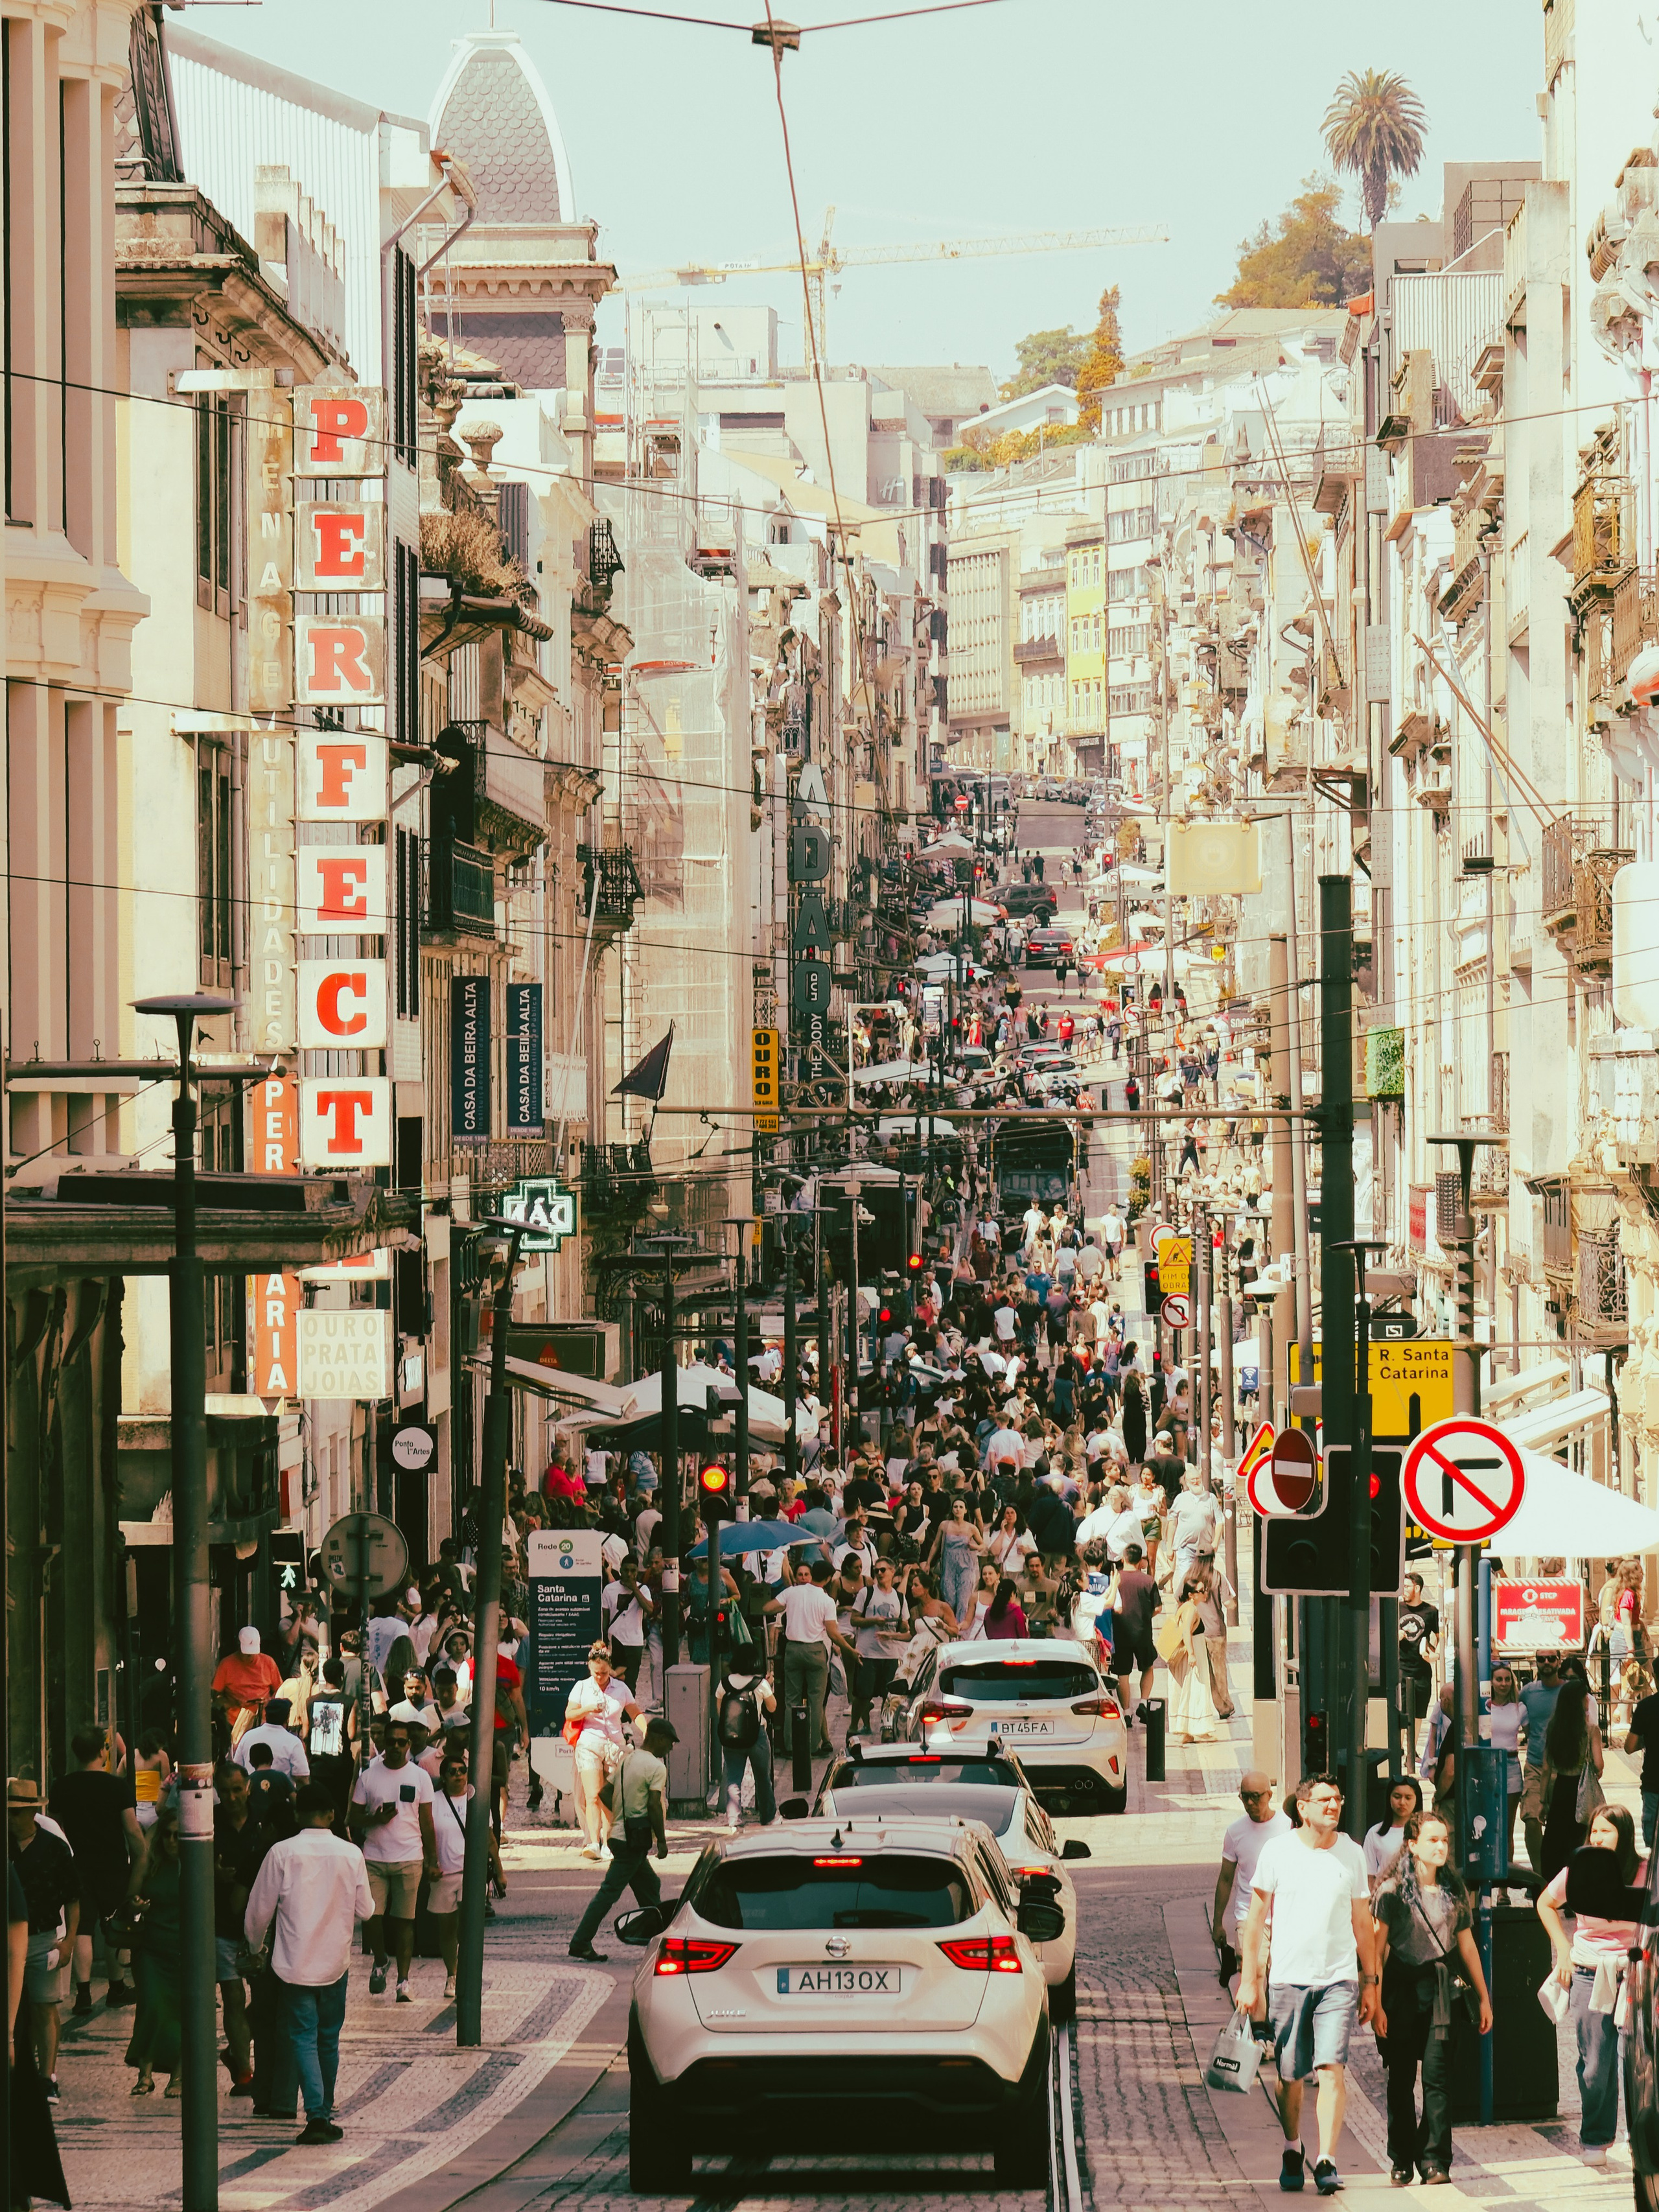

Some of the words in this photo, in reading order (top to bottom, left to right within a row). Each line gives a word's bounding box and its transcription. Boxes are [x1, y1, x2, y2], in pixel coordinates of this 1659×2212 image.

[257, 412, 283, 688] MENAGE
[308, 399, 375, 1267] PERFECT
[262, 737, 284, 1049] UTILIDADES
[465, 983, 476, 1018] ALTA
[519, 988, 529, 1021] ALTA
[465, 1020, 476, 1064] BEIRA
[519, 1022, 529, 1062] BEIRA
[519, 1065, 529, 1084] DA
[755, 1032, 771, 1095] OURO
[811, 1054, 822, 1079] THE
[465, 1067, 476, 1088] DA
[465, 1090, 476, 1130] CASA
[519, 1086, 529, 1123] CASA
[264, 1080, 288, 1389] PERARIA
[304, 1316, 378, 1337] OURO
[303, 1344, 378, 1365] PRATA
[1380, 1349, 1395, 1361] R.
[1403, 1348, 1449, 1360] Santa
[305, 1371, 378, 1391] JOIAS
[1380, 1366, 1449, 1379] Catarina
[395, 1440, 413, 1455] Ponto
[537, 1584, 565, 1593] Santa
[537, 1594, 578, 1602] Catarina
[1216, 2058, 1238, 2071] Normal
